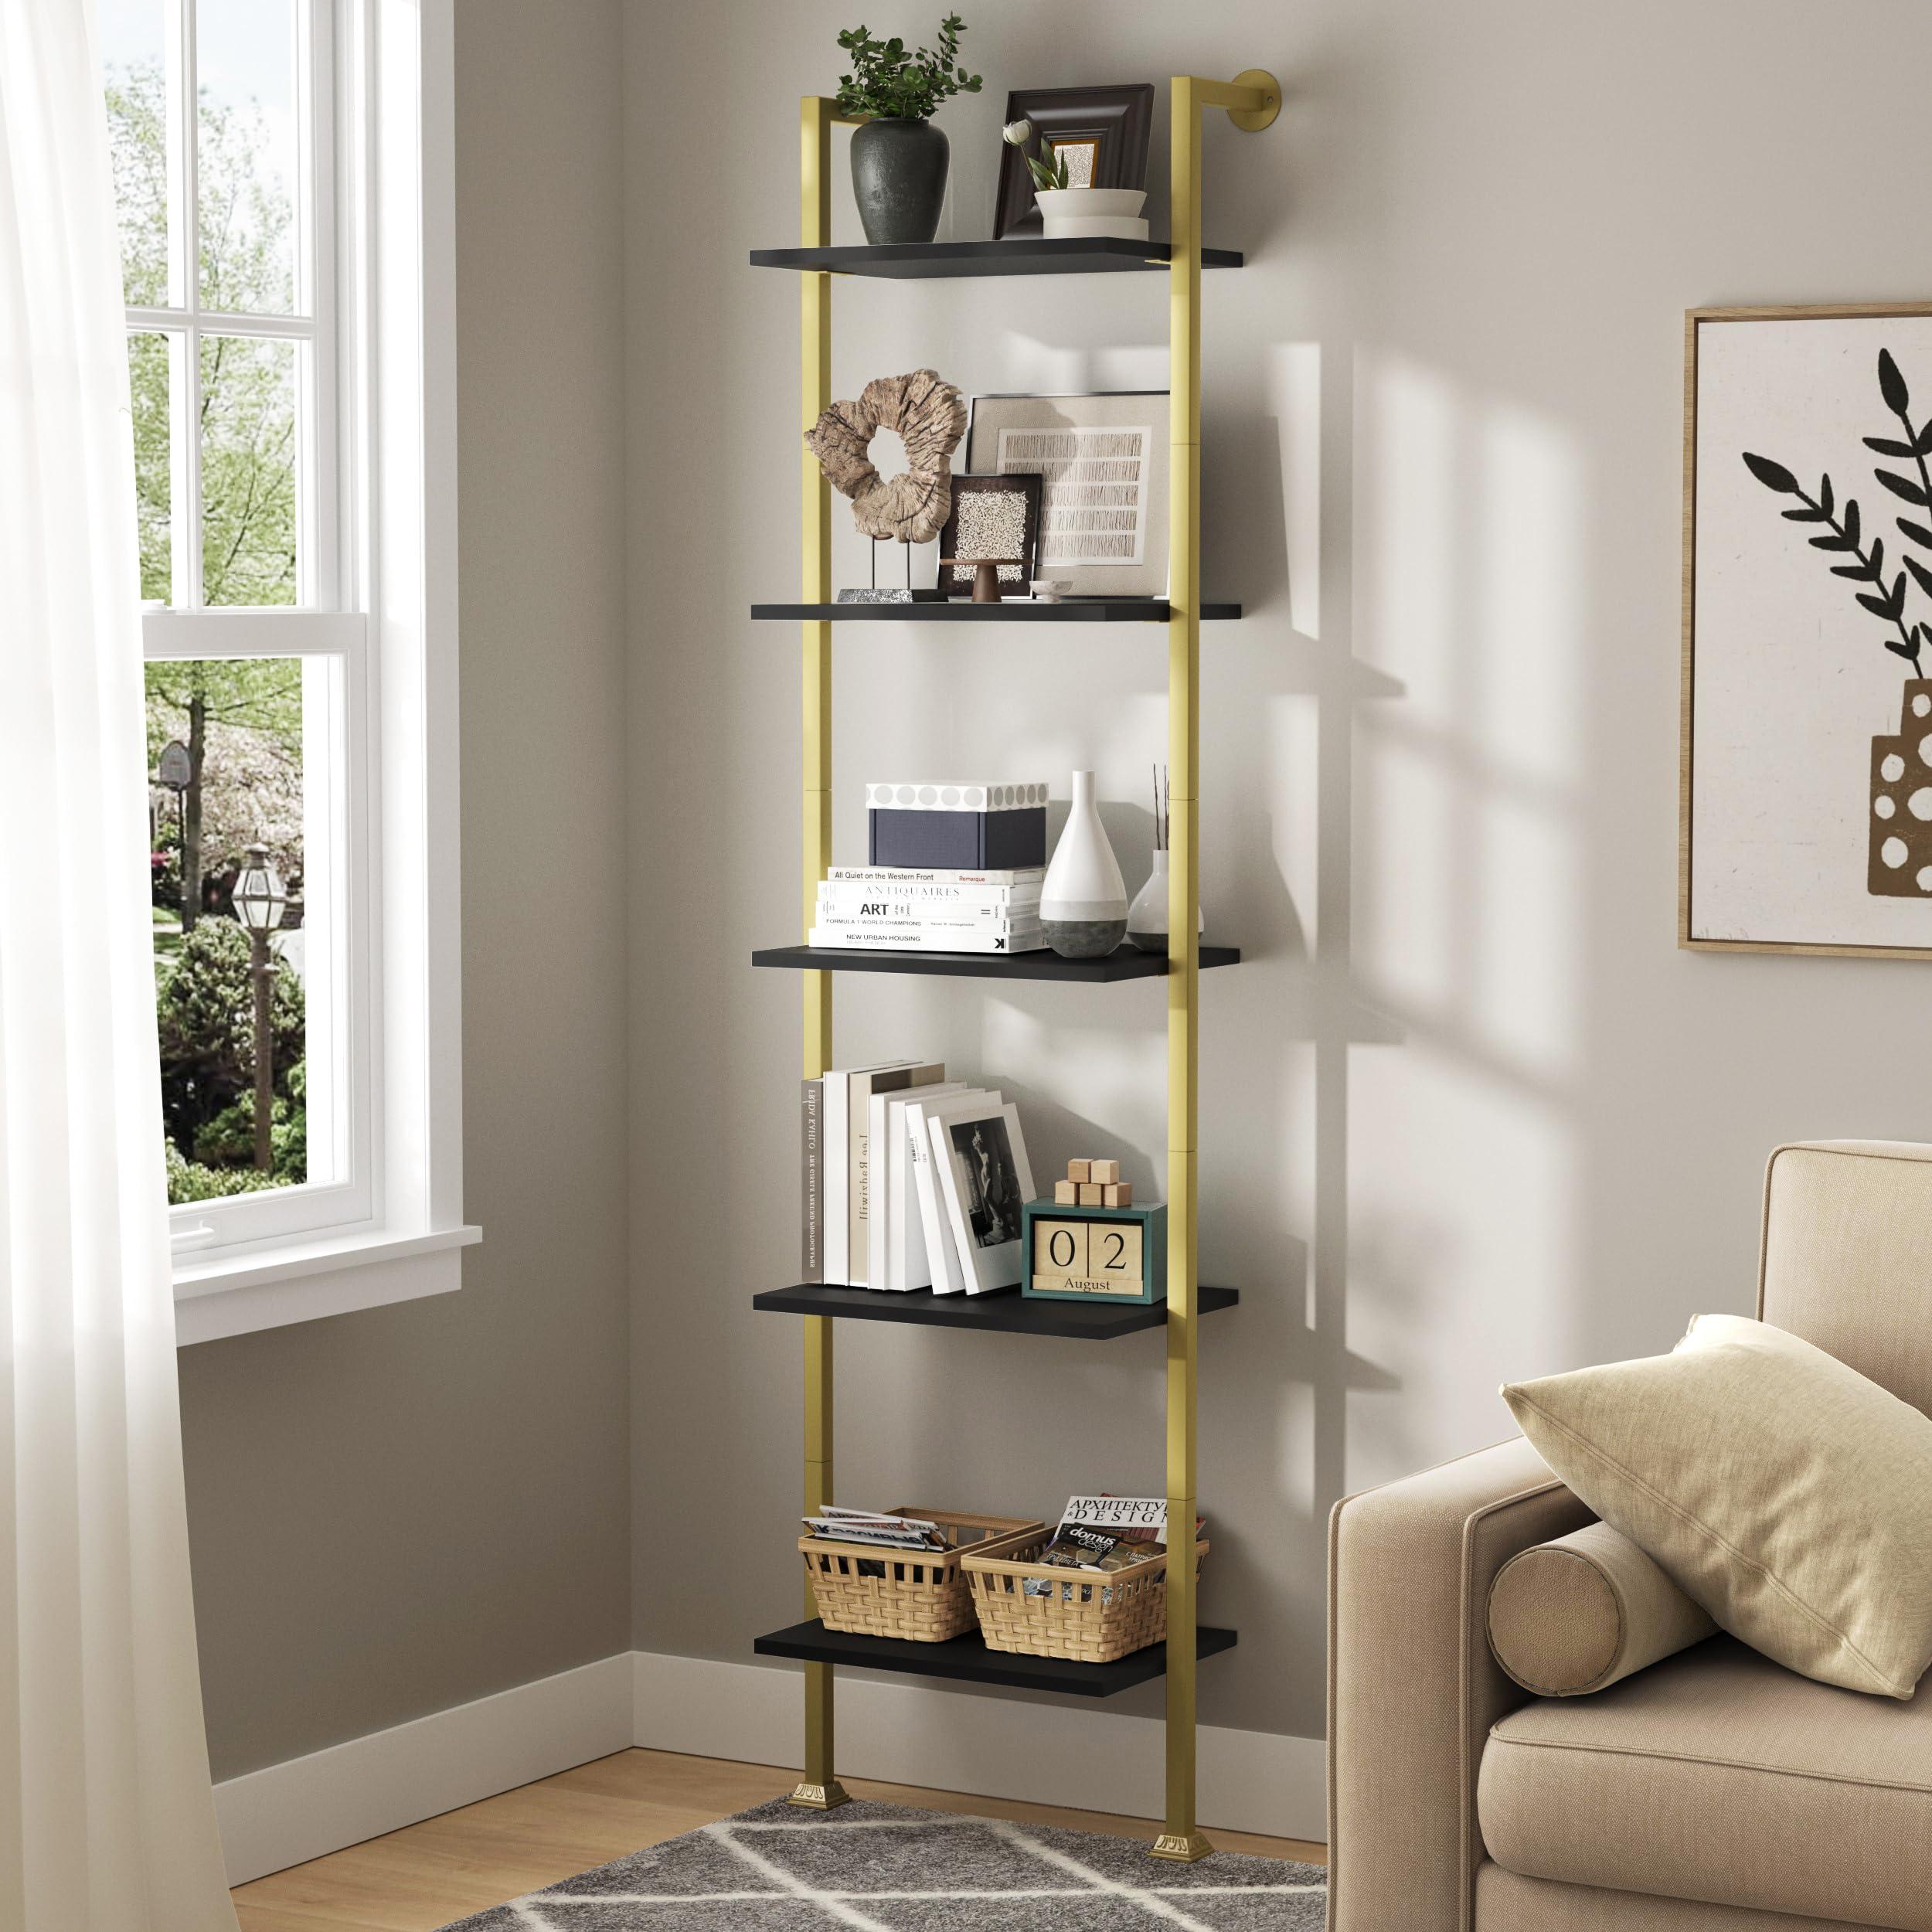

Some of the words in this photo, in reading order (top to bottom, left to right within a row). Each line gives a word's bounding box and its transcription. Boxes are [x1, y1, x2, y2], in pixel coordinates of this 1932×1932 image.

[845, 871, 863, 879] Quiet
[865, 886, 961, 897] ANTIQUAIRES
[859, 903, 889, 916] ART
[1064, 1277, 1111, 1293] August
[1070, 1527, 1117, 1546] domus
[1077, 1537, 1114, 1553] design
